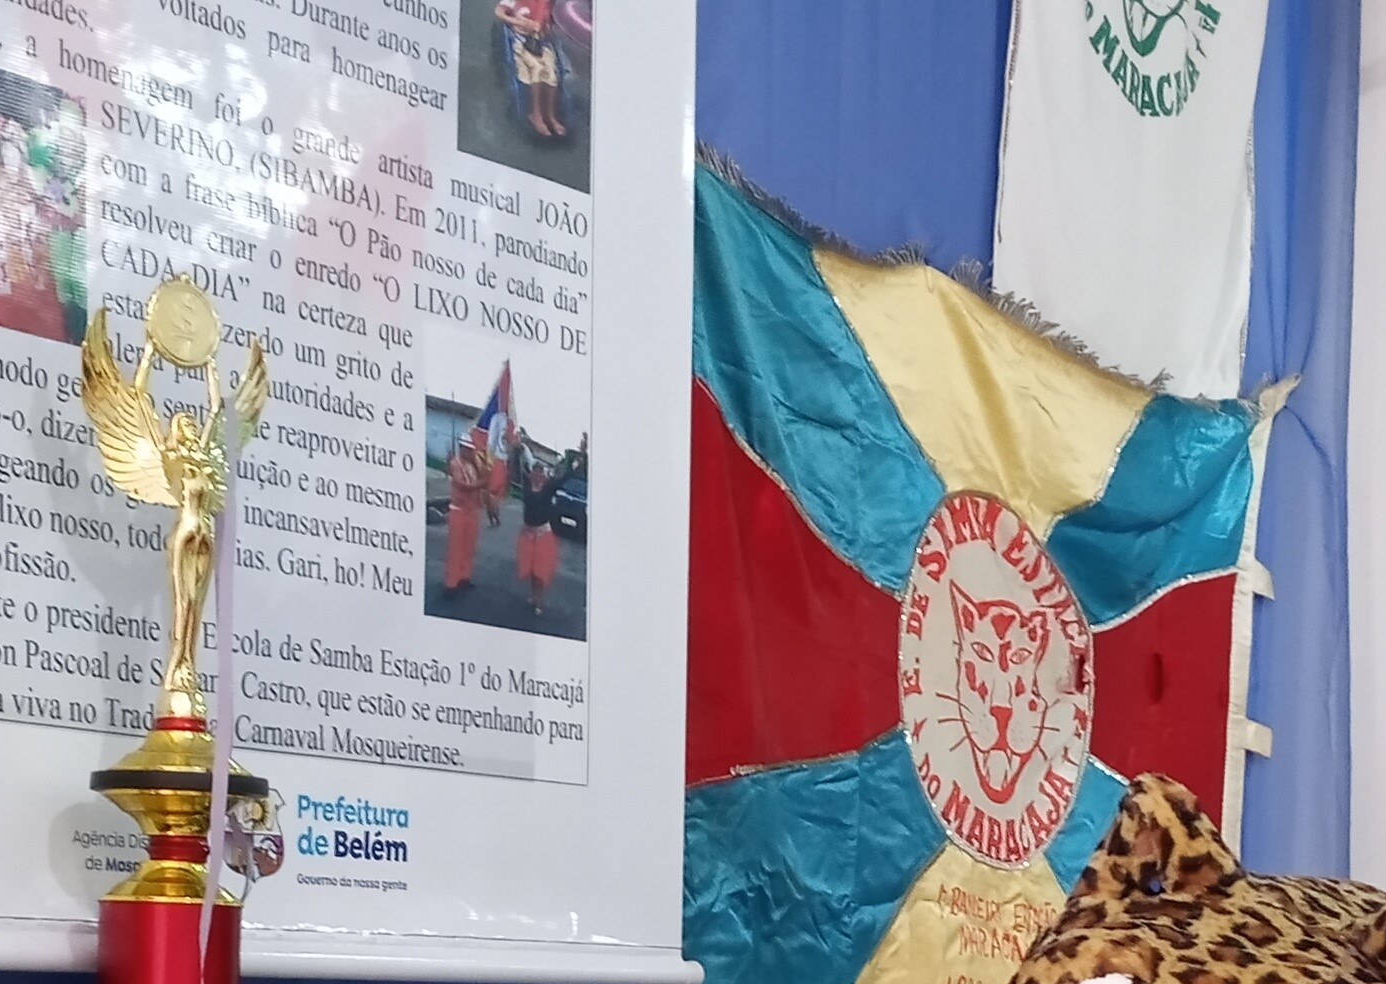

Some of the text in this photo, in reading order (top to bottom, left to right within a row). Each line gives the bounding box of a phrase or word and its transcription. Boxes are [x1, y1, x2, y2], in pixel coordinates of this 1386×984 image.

[291, 0, 448, 70] Durante anos os
[267, 30, 311, 63] para
[332, 47, 448, 111] homenagear
[59, 39, 192, 110] homenagem
[215, 93, 241, 126] foi
[293, 125, 361, 164] grande
[379, 152, 434, 190] artista
[451, 177, 521, 217] musical
[536, 199, 588, 238] JOÃO
[100, 154, 147, 187] com
[186, 173, 236, 211] frase
[368, 227, 402, 262] Pão
[412, 250, 465, 280] nosso
[476, 262, 497, 289] de
[507, 276, 544, 304] cada
[250, 150, 385, 218] (SIBAMBA).
[396, 194, 426, 229] Em
[435, 207, 486, 246] 2011,
[495, 232, 588, 278] parodiando
[101, 200, 193, 245] resolveu
[206, 231, 257, 262] criar
[296, 255, 361, 293] enredo
[414, 283, 468, 322] LIXO
[480, 301, 550, 345] NOSSO
[560, 325, 587, 356] DE
[101, 239, 176, 282] CADA
[263, 290, 286, 315] na
[299, 299, 367, 336] certeza
[379, 323, 413, 351] que
[268, 379, 374, 421] utoridades
[295, 341, 414, 390] um grito de
[278, 423, 397, 470] reaproveitar
[91, 473, 115, 498] os
[244, 496, 414, 557] incansavelmente,
[316, 476, 339, 498] ao
[346, 481, 414, 513] mesmo
[49, 510, 120, 548] nosso,
[235, 539, 271, 572] ias.
[277, 548, 329, 584] Gari,
[335, 556, 365, 588] ho!
[372, 564, 414, 597] Meu
[907, 585, 930, 640] DE
[24, 599, 39, 623] o
[47, 603, 160, 643] presidente
[280, 634, 303, 663] de
[311, 638, 373, 674] Samba
[379, 648, 451, 688] Estação
[481, 665, 502, 693] do
[508, 668, 584, 708] Maracajá
[13, 686, 62, 721] viva
[68, 703, 97, 725] no
[234, 714, 326, 752] Carnaval
[331, 724, 465, 767] Mosqueirense.
[24, 639, 110, 682] Pascoal
[117, 655, 143, 685] de
[241, 670, 312, 709] Castro,
[317, 688, 352, 718] que
[357, 690, 406, 721] estão
[411, 700, 431, 723] se
[435, 704, 545, 738] empenhando
[548, 717, 584, 745] para
[297, 793, 409, 829] Prefeitura
[918, 752, 941, 800] DO
[72, 829, 126, 848] Agência
[85, 854, 103, 871] de
[298, 826, 408, 863] de Belém
[297, 872, 408, 893] Governo da nossa gente
